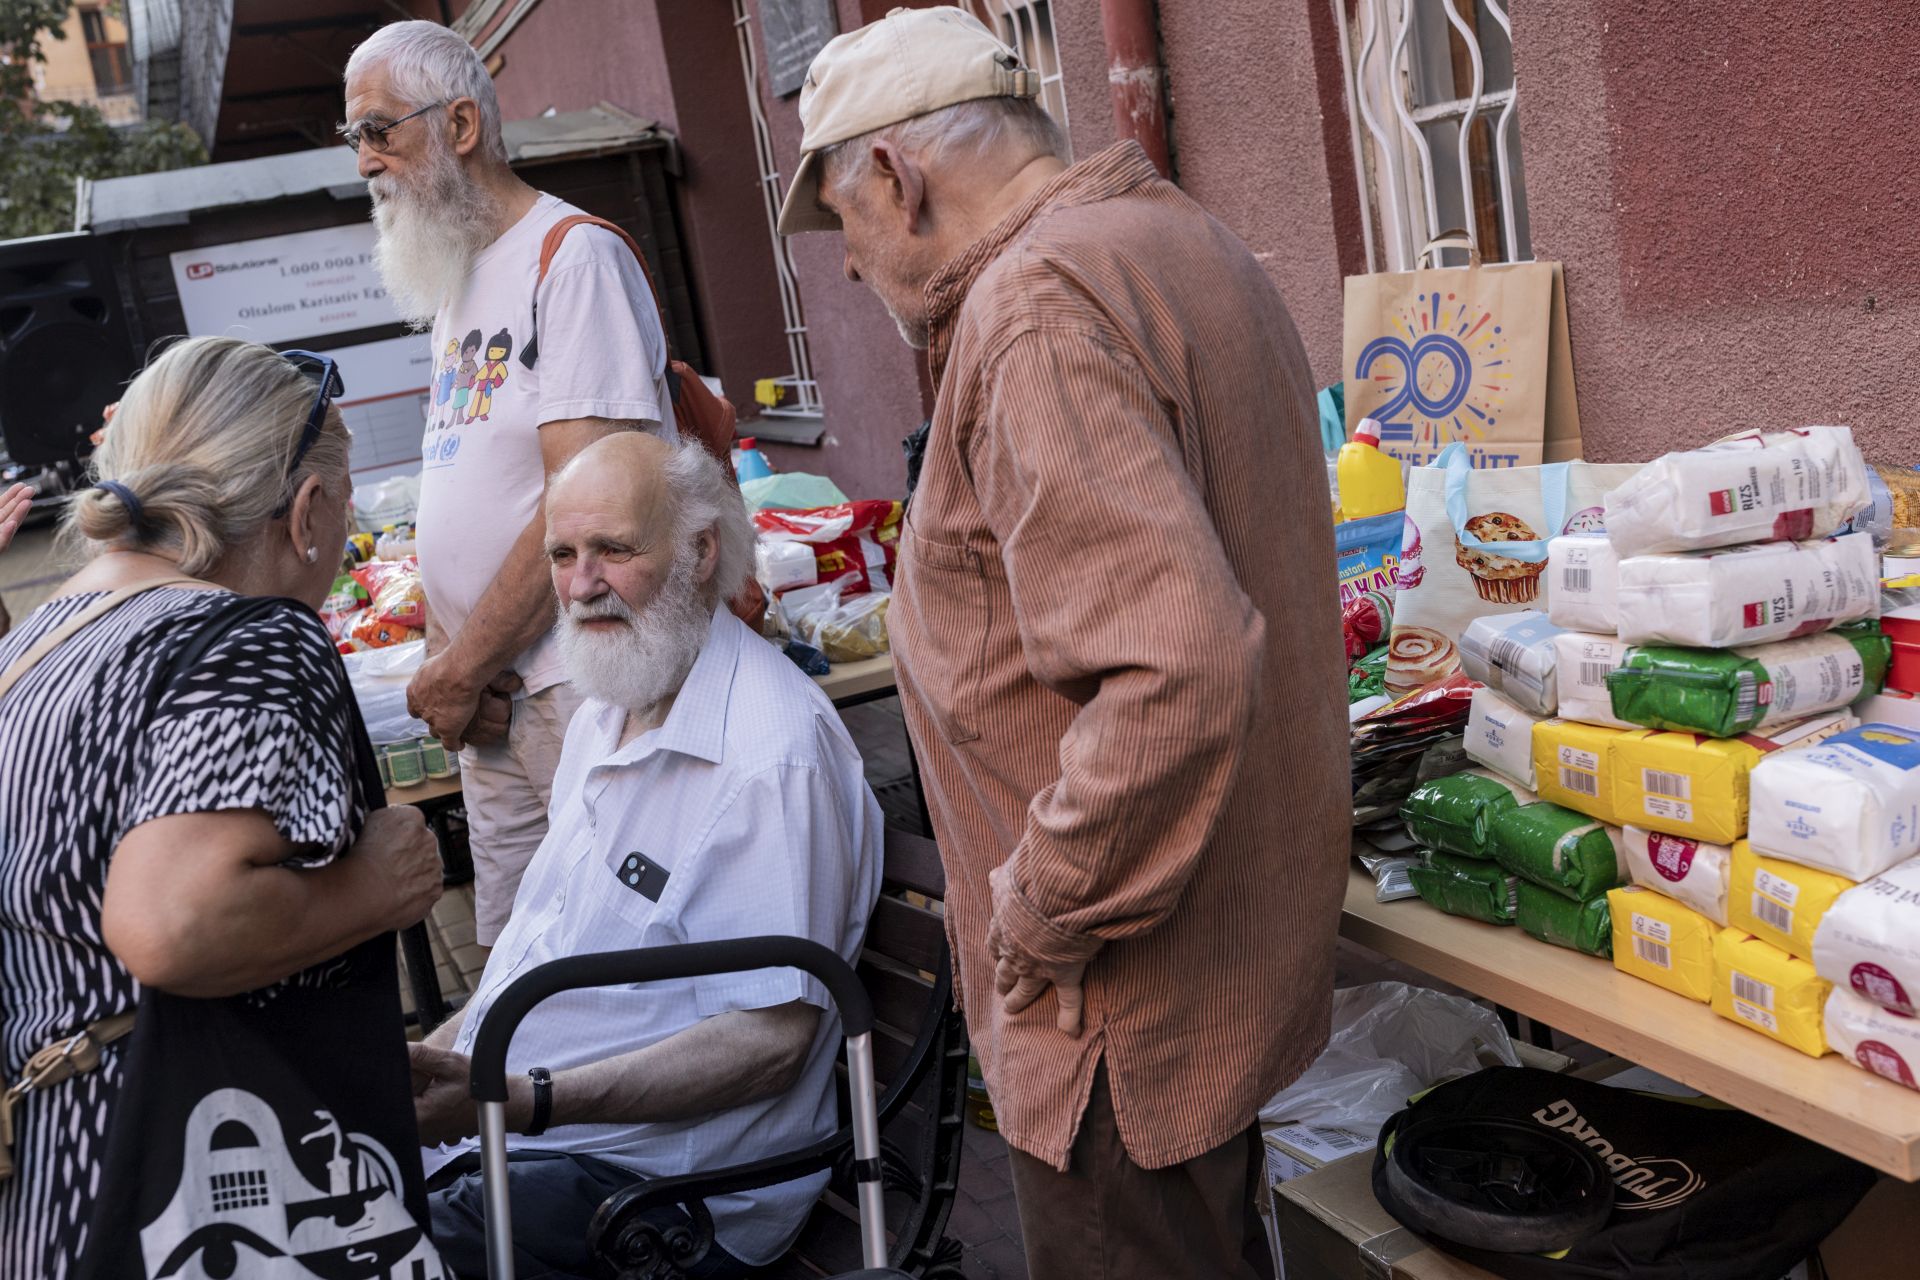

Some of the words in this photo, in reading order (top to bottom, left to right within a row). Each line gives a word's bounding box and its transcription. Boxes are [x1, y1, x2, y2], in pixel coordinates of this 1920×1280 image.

[215, 257, 279, 273] Solutions
[239, 301, 296, 319] Oltalom
[1355, 334, 1472, 440] 20
[1740, 484, 1755, 512] RIZS
[1339, 562, 1367, 579] nstant
[1339, 558, 1401, 609] AKAÓ
[1773, 597, 1786, 624] RIZS
[1532, 1098, 1678, 1201] TUBORG
